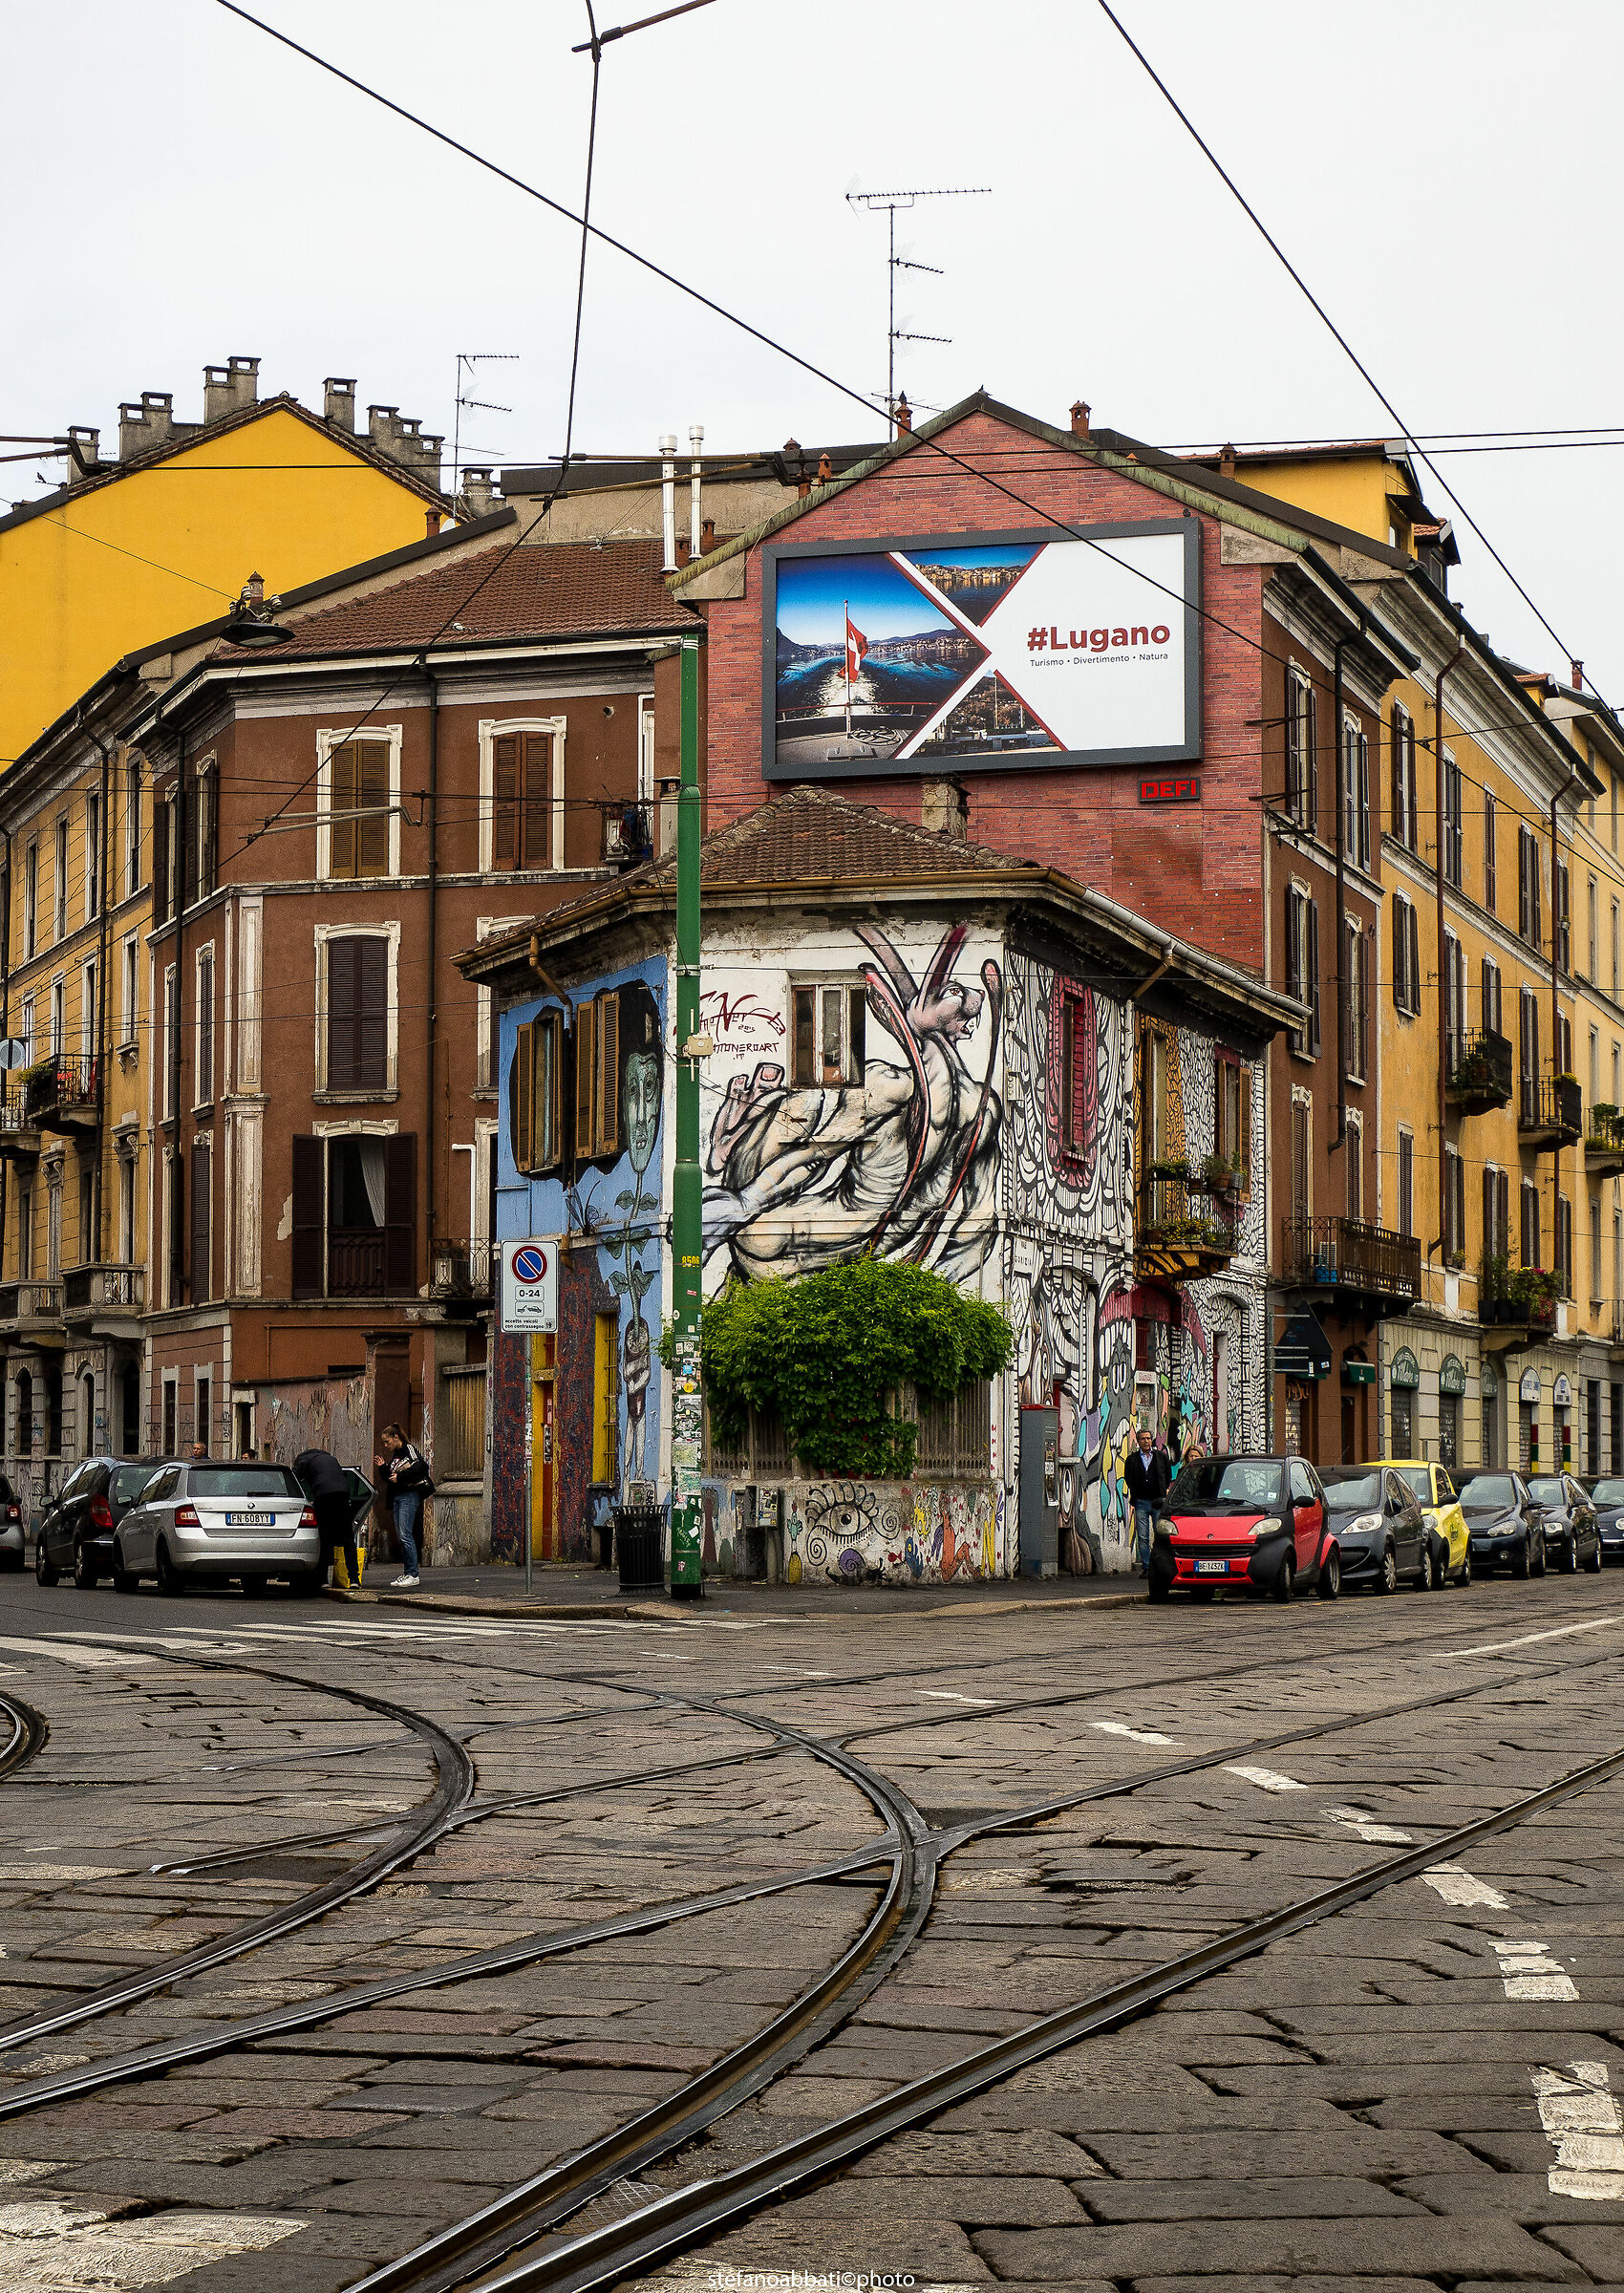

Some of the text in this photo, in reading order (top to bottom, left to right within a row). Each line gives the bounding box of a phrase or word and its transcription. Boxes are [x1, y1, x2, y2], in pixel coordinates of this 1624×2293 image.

[1027, 625, 1170, 653] #Lugano
[1030, 653, 1168, 667] Turismo Divertimento Natura
[1141, 780, 1196, 799] DEFI
[519, 1289, 541, 1297] 0-24
